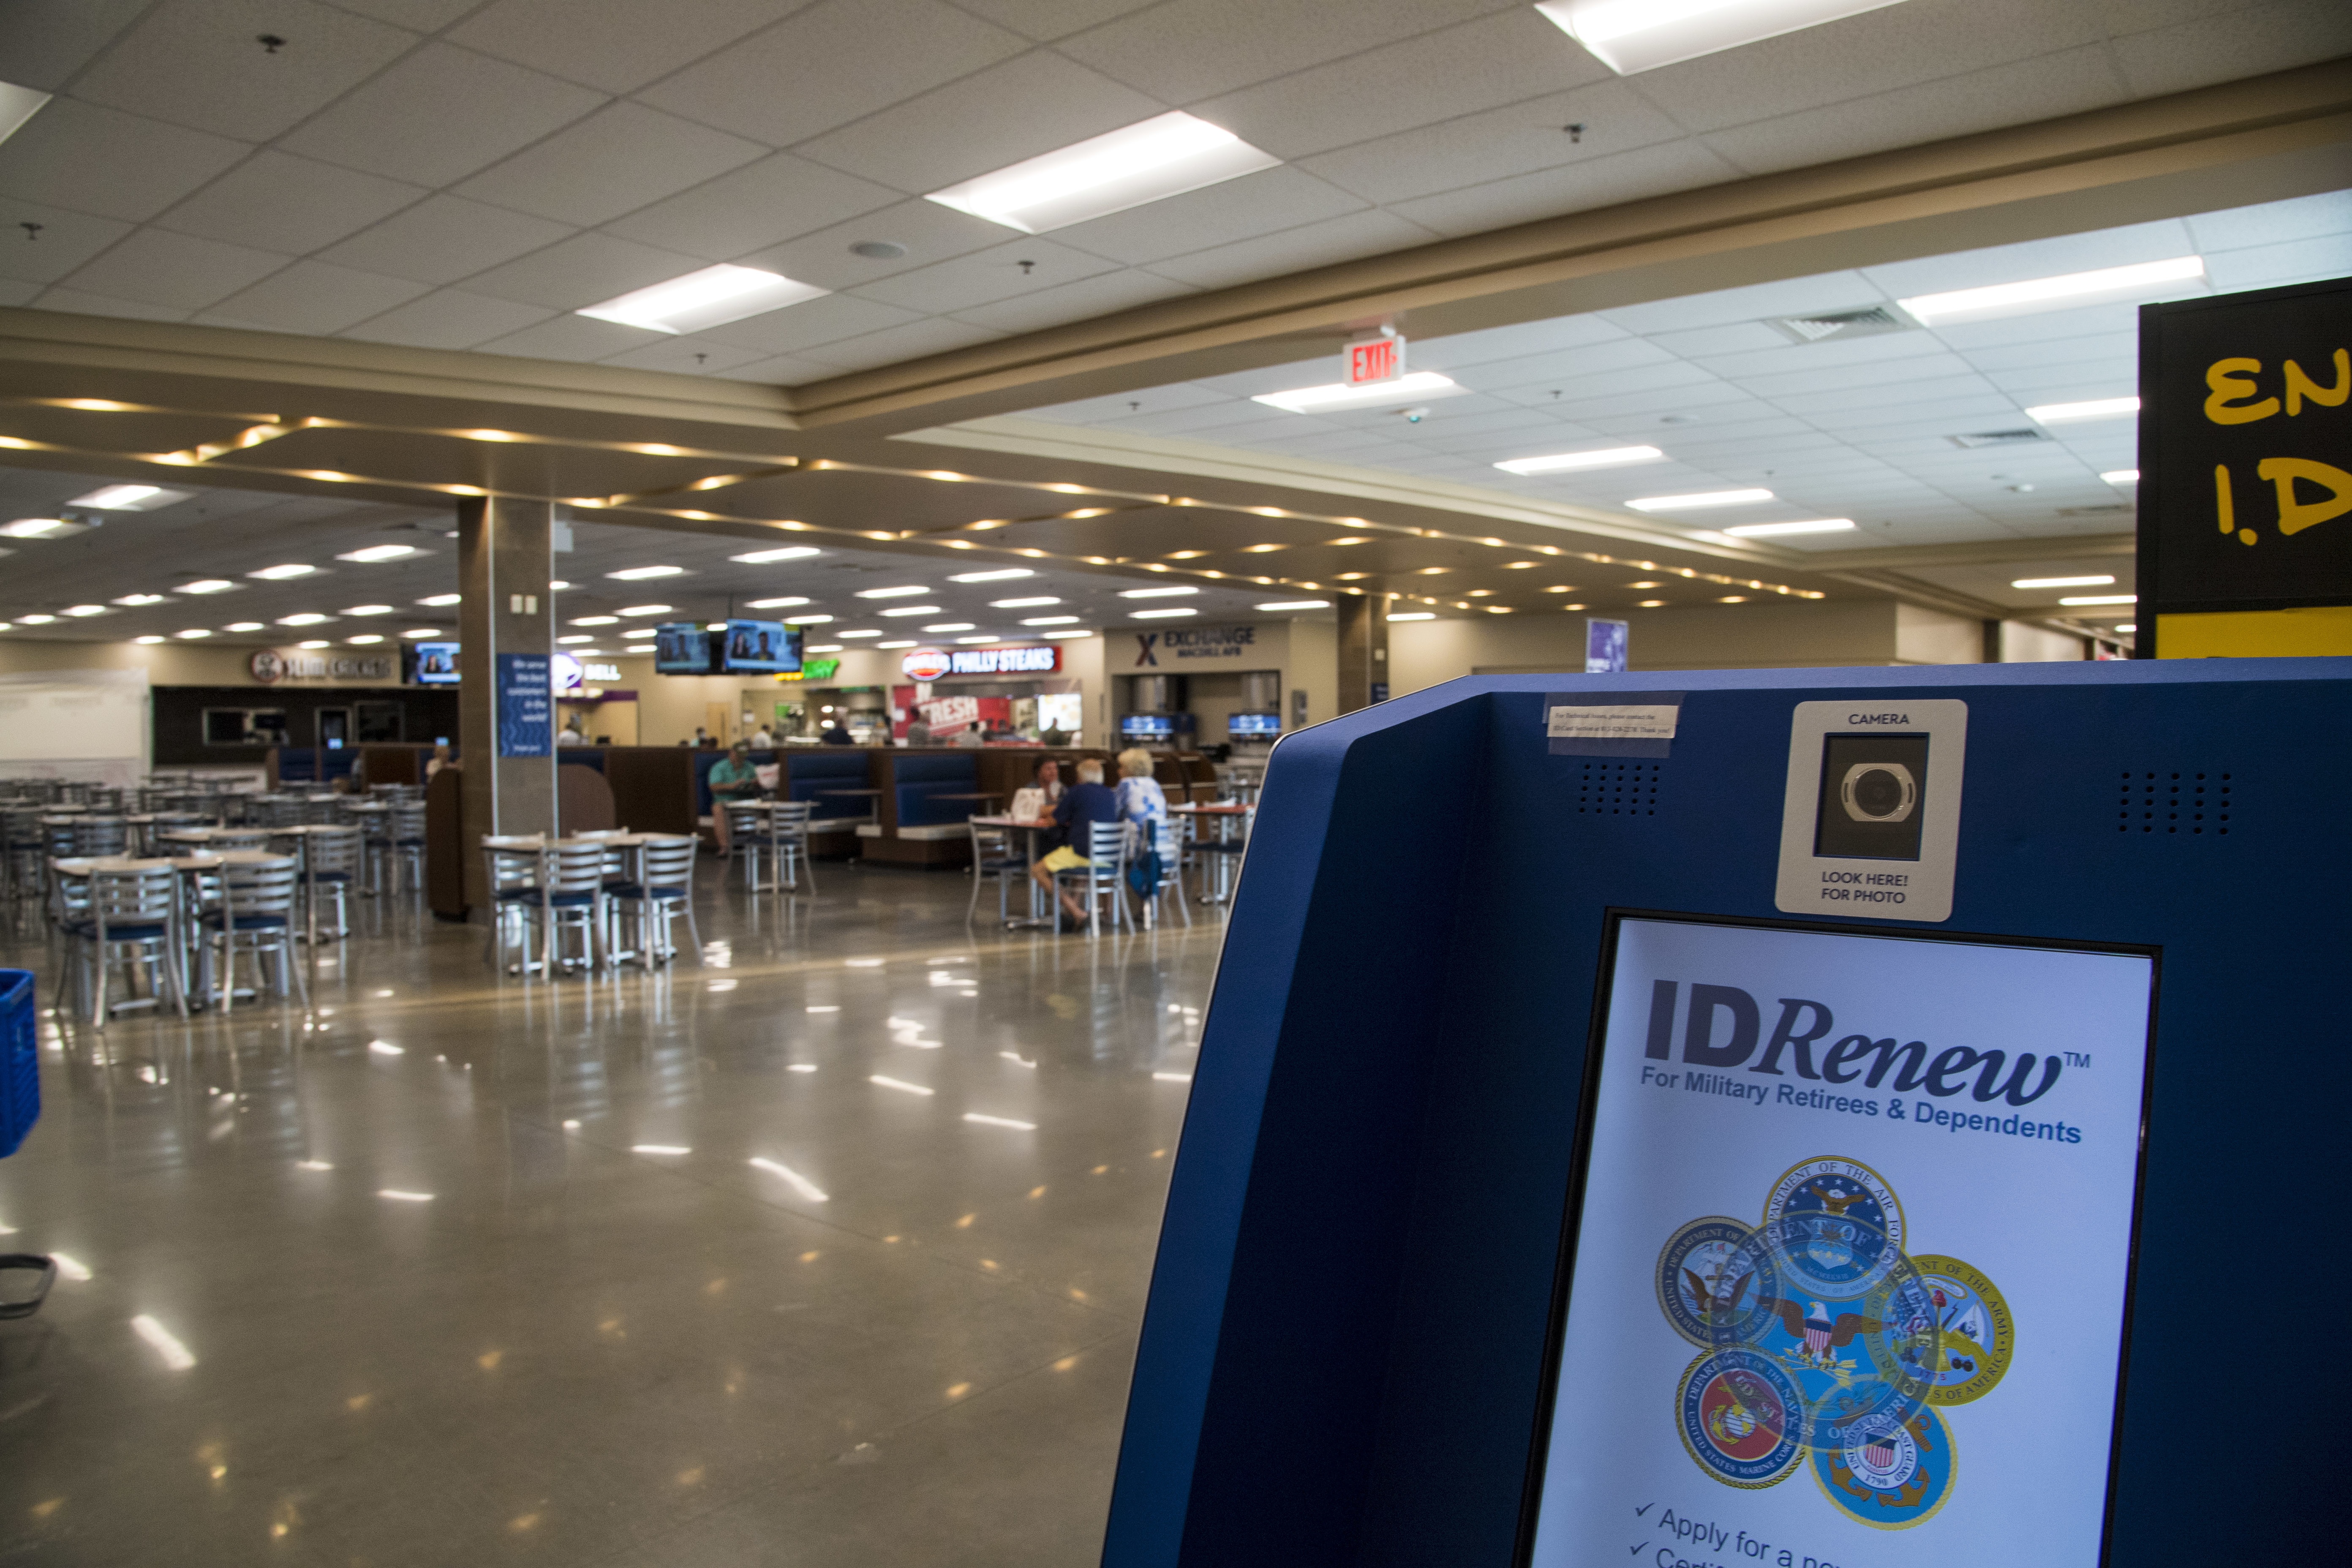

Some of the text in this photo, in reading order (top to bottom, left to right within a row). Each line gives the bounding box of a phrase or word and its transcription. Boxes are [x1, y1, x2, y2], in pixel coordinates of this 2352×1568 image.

[1353, 341, 1393, 382] EXIT
[1164, 627, 1255, 647] EXCHANGE
[1223, 646, 1241, 656] AFB
[585, 664, 622, 681] BELL
[952, 651, 999, 673] PHILLY
[998, 647, 1055, 672] STEAKS
[1848, 713, 1910, 724] CAMERA
[1821, 871, 1908, 887] LOOK HERE!
[1821, 888, 1906, 904] FOR PHOTO
[1640, 1065, 2082, 1144] For Military Retirees & Dependents
[1769, 1166, 1812, 1240] DEPARTMENT
[1818, 1162, 1837, 1173] OF
[1846, 1164, 1873, 1186] THE
[1874, 1189, 1894, 1211] AIR
[1668, 1228, 1723, 1267] DEPARTMENT
[1726, 1230, 1742, 1241] OF
[1840, 1224, 1872, 1246] OF
[1665, 1279, 1685, 1318] UNITED
[1946, 1264, 1962, 1275] OF
[1967, 1273, 1990, 1294] THE
[1989, 1300, 2008, 1337] ARMY
[1945, 1388, 1963, 1400] OF
[1964, 1348, 2006, 1394] AMERICA
[1688, 1411, 1707, 1449] UNITED
[1705, 1449, 1737, 1473] STATES
[1739, 1459, 1777, 1475] MARINE
[1865, 1474, 1889, 1486] 1790
[1894, 1451, 1914, 1482] GUARD
[1658, 1508, 1729, 1552] Apply
[1736, 1530, 1771, 1560] for
[1777, 1549, 1793, 1568] a
